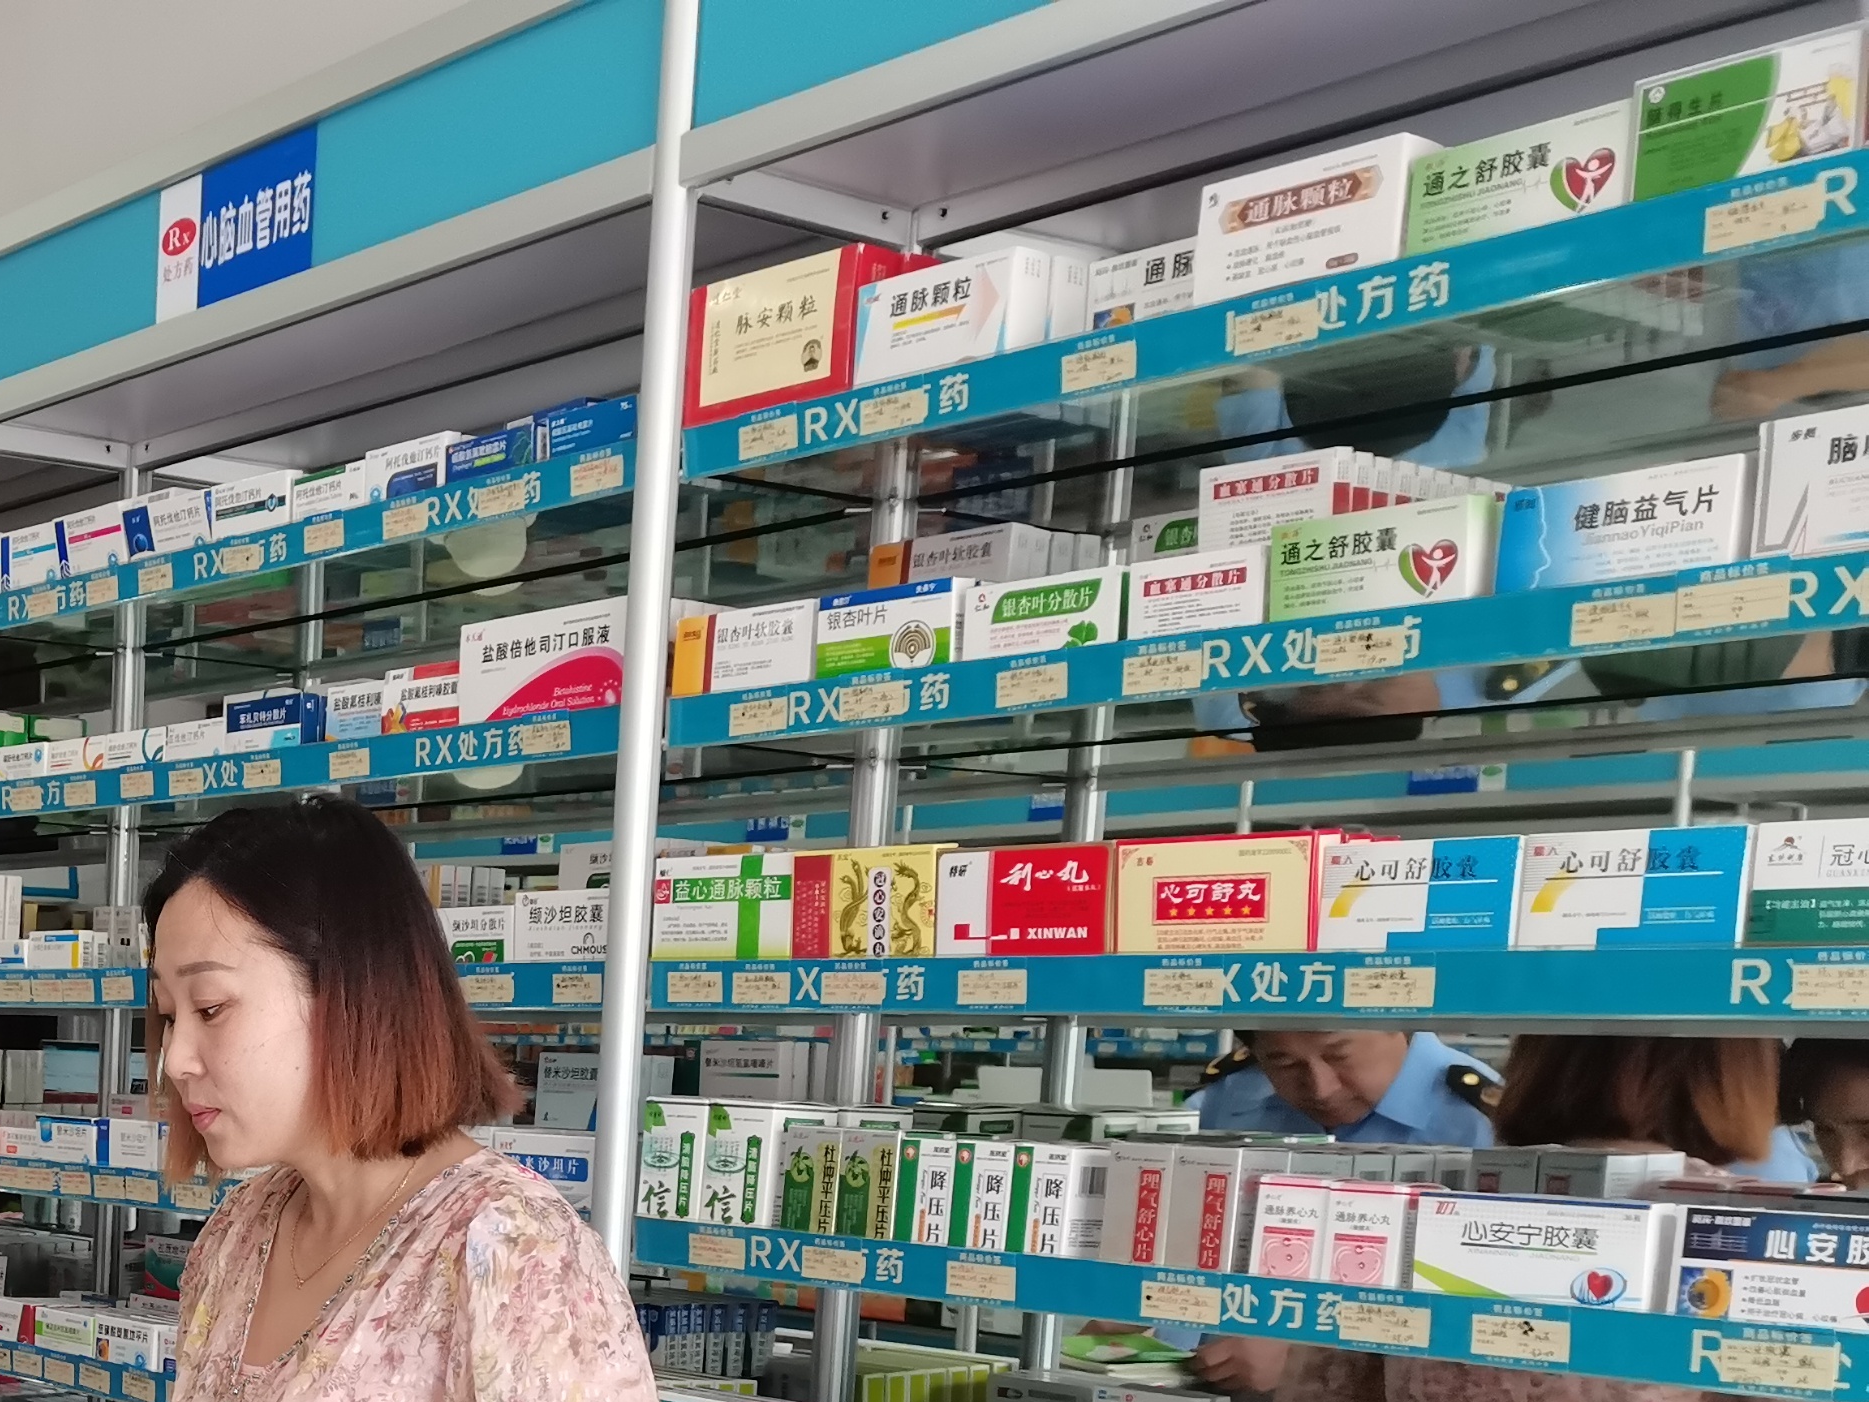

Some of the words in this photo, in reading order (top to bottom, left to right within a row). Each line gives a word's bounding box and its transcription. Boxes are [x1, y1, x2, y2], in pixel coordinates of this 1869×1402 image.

[1421, 142, 1551, 199] 通之舒胶囊
[1245, 176, 1353, 224] 通脉颗粒
[200, 169, 312, 269] 心脑血管用药
[168, 227, 192, 251] Rx
[889, 277, 972, 318] 通脉颗粒
[735, 294, 818, 336] 脉安颗粒
[1827, 432, 1869, 466] 脑
[1219, 469, 1316, 498] 血塞通分散片
[1573, 484, 1720, 533] 健脑益气片
[1280, 526, 1398, 567] 通之舒胶囊
[1149, 568, 1240, 596] 血塞通分散片
[826, 605, 888, 630] 银杏叶片
[1001, 585, 1093, 617] 银杏叶分散片
[481, 624, 611, 664] 盐酸倍他司汀口服液
[716, 617, 794, 644] 银杏叶软胶囊
[1000, 859, 1090, 892] 利心丸
[1355, 853, 1479, 882] 心可舒胶囊
[1559, 846, 1702, 875] 心可舒胶囊
[673, 876, 783, 902] 益心通脉颗粒
[1160, 879, 1262, 907] 心可舒丸
[451, 918, 506, 934] 缬沙坦分散片
[528, 904, 604, 925] 缬沙坦胶囊
[1026, 927, 1088, 940] XINWAN
[817, 1145, 836, 1235] 杜仲平压片
[874, 1148, 893, 1240] 杜仲平压片
[926, 1169, 947, 1244] 降压片
[981, 1174, 1004, 1249] 降压片
[1040, 1177, 1064, 1254] 降压片
[1133, 1171, 1159, 1261] 理气舒心片
[1199, 1176, 1226, 1268] 理气舒心片
[1263, 1203, 1320, 1221] 通脉养心丸
[1334, 1209, 1391, 1227] 通脉养心丸
[1460, 1219, 1600, 1252] 心安宁胶囊
